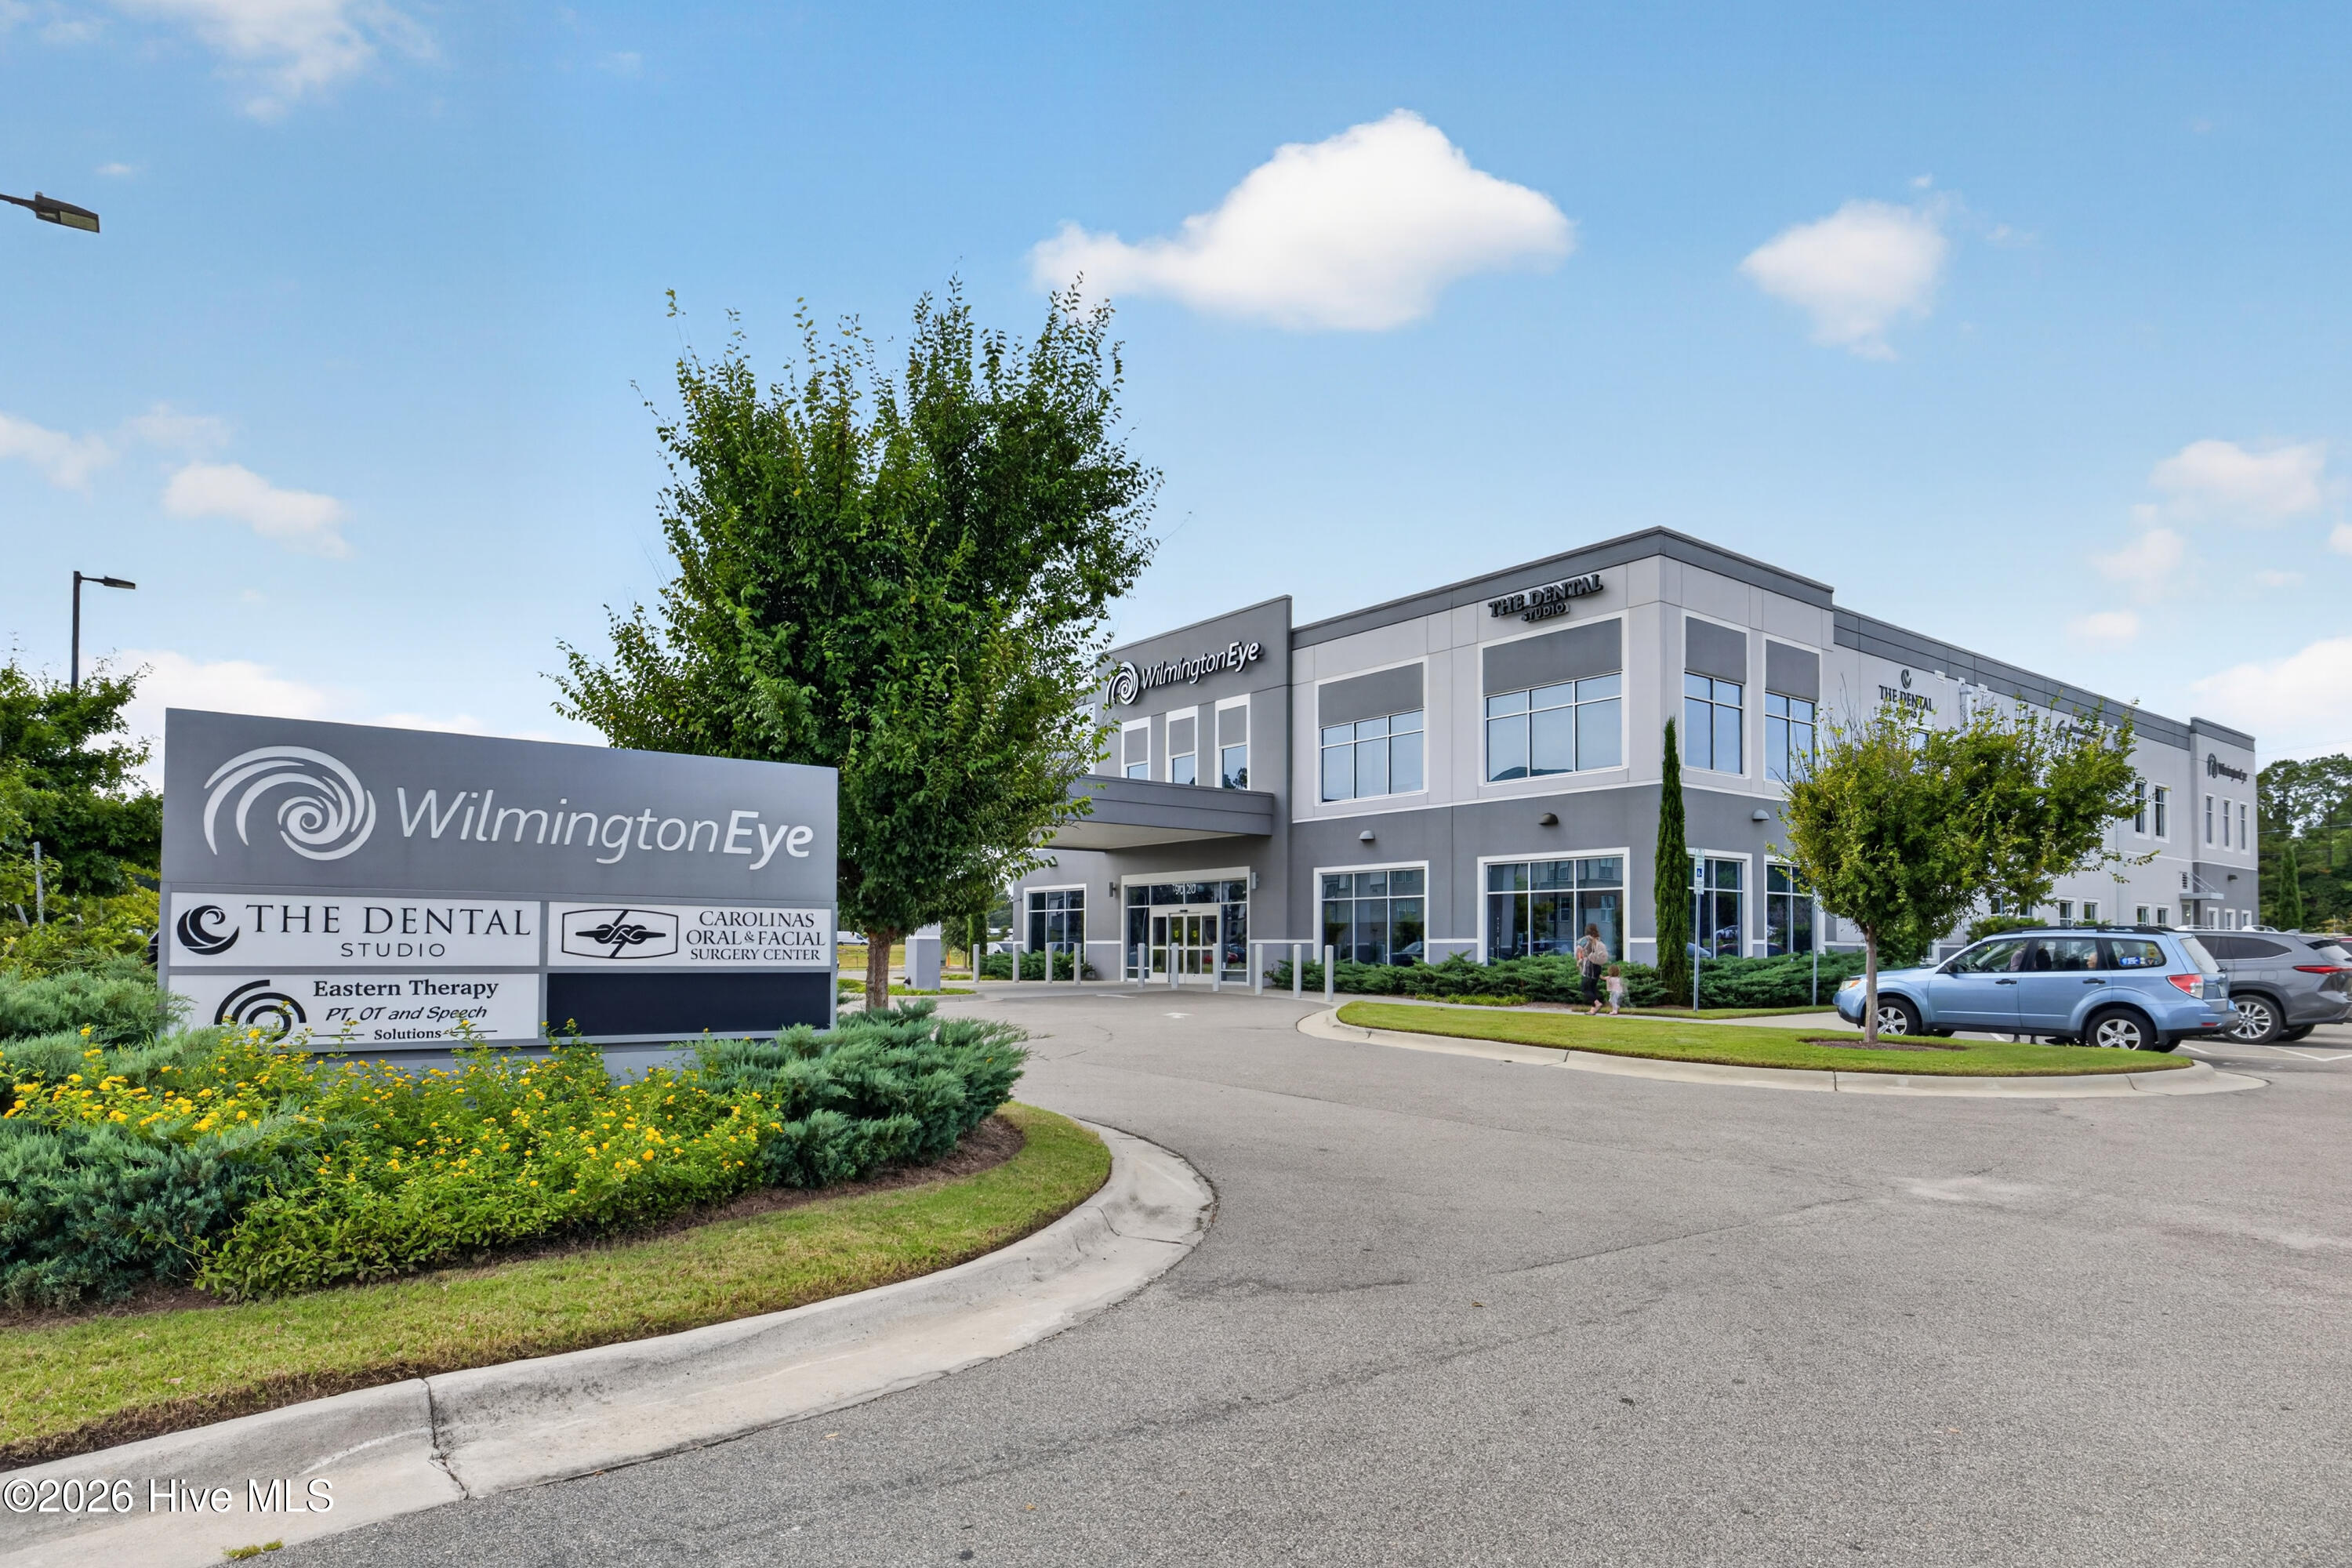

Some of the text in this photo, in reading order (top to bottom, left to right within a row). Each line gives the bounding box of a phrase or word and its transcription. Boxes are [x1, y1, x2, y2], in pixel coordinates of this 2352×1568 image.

[1488, 574, 1603, 618] THE DENTAL
[1523, 603, 1569, 622] STUDIO
[1142, 641, 1261, 690] WilmingtonEye
[1878, 684, 1897, 702] THE
[397, 786, 814, 870] WilmingtonEye
[245, 904, 532, 936] THE DENTAL
[699, 910, 815, 928] CAROLINAS
[686, 929, 826, 946] ORAL & FACIAL
[340, 942, 446, 958] STUDIO
[690, 948, 821, 961] SURGERY CENTER
[313, 978, 499, 1000] Eastern Therapy
[325, 1005, 488, 1022] PT, OT and Speech
[373, 1028, 442, 1041] Solutions
